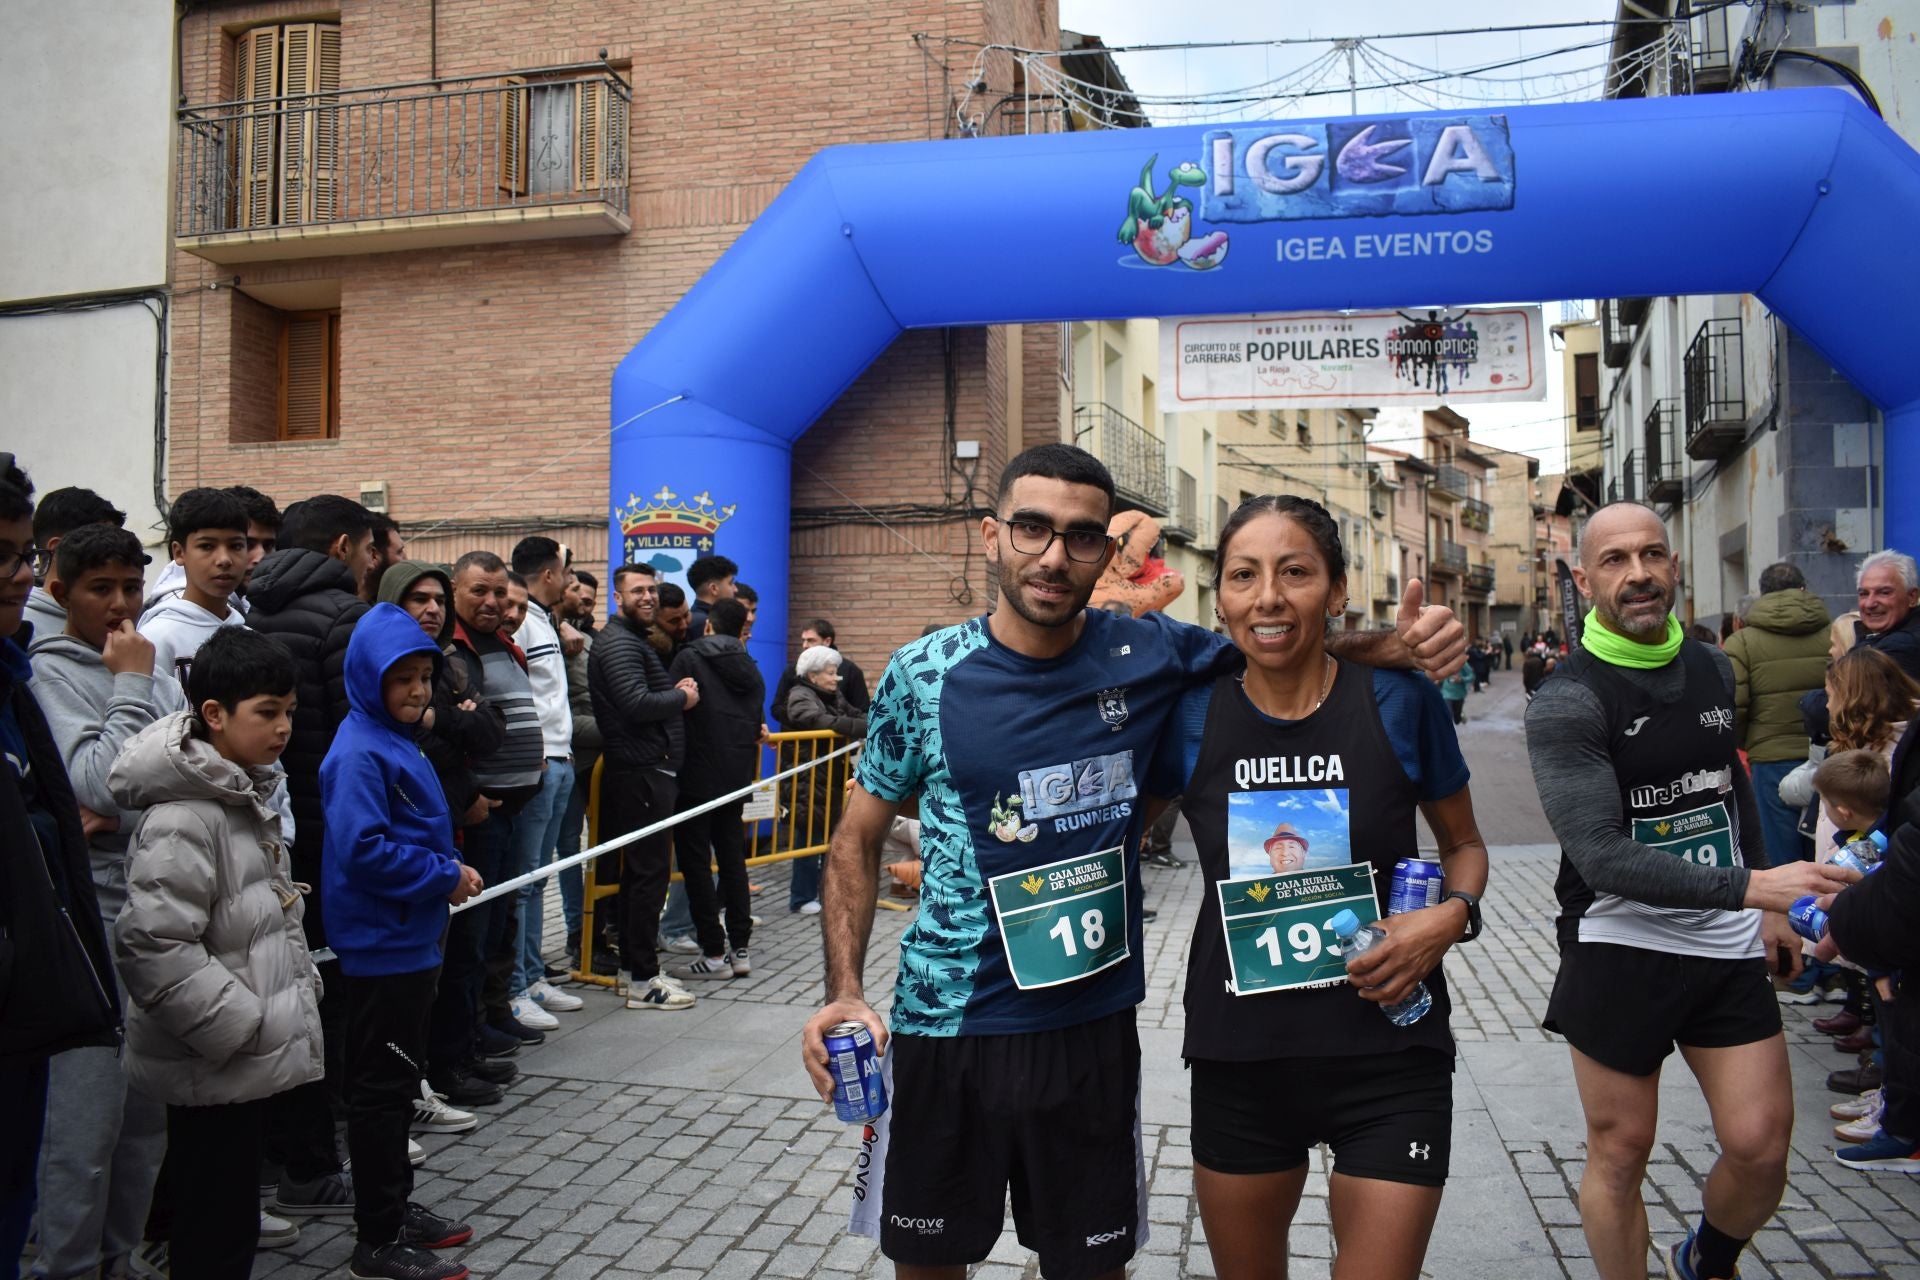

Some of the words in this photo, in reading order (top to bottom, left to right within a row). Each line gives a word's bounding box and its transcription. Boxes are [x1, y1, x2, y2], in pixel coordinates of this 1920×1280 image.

[1212, 124, 1502, 196] IGEA
[1276, 237, 1347, 262] IGEA
[1354, 229, 1494, 258] EVENTOS
[1184, 343, 1227, 353] CIRCUITO
[1229, 342, 1242, 352] DE
[1246, 338, 1380, 362] POPULARES
[1434, 338, 1478, 354] OPTICA
[1184, 353, 1242, 364] CARRERAS
[1257, 366, 1267, 374] La
[1269, 365, 1290, 376] Rioja
[637, 536, 670, 548] VILLA
[673, 535, 692, 547] DE
[1234, 754, 1344, 790] QUELLCA
[1023, 760, 1132, 809] IGEA
[1054, 802, 1132, 833] RUNNERS
[1673, 818, 1689, 827] CAJA
[1689, 813, 1710, 823] RURAL
[1673, 826, 1683, 834] DE
[1684, 819, 1714, 832] NAVARRA
[1048, 869, 1074, 881] CAJA
[1074, 862, 1104, 875] RURAL
[1050, 881, 1066, 891] DE
[1067, 869, 1109, 887] NAVARRA
[1275, 879, 1301, 890] CAJA
[1300, 874, 1338, 886] RURAL
[1276, 889, 1292, 899] DE
[1293, 882, 1345, 896] NAVARRA
[1049, 908, 1106, 957] 18
[891, 1214, 945, 1229] norave
[918, 1228, 944, 1236] SPORT
